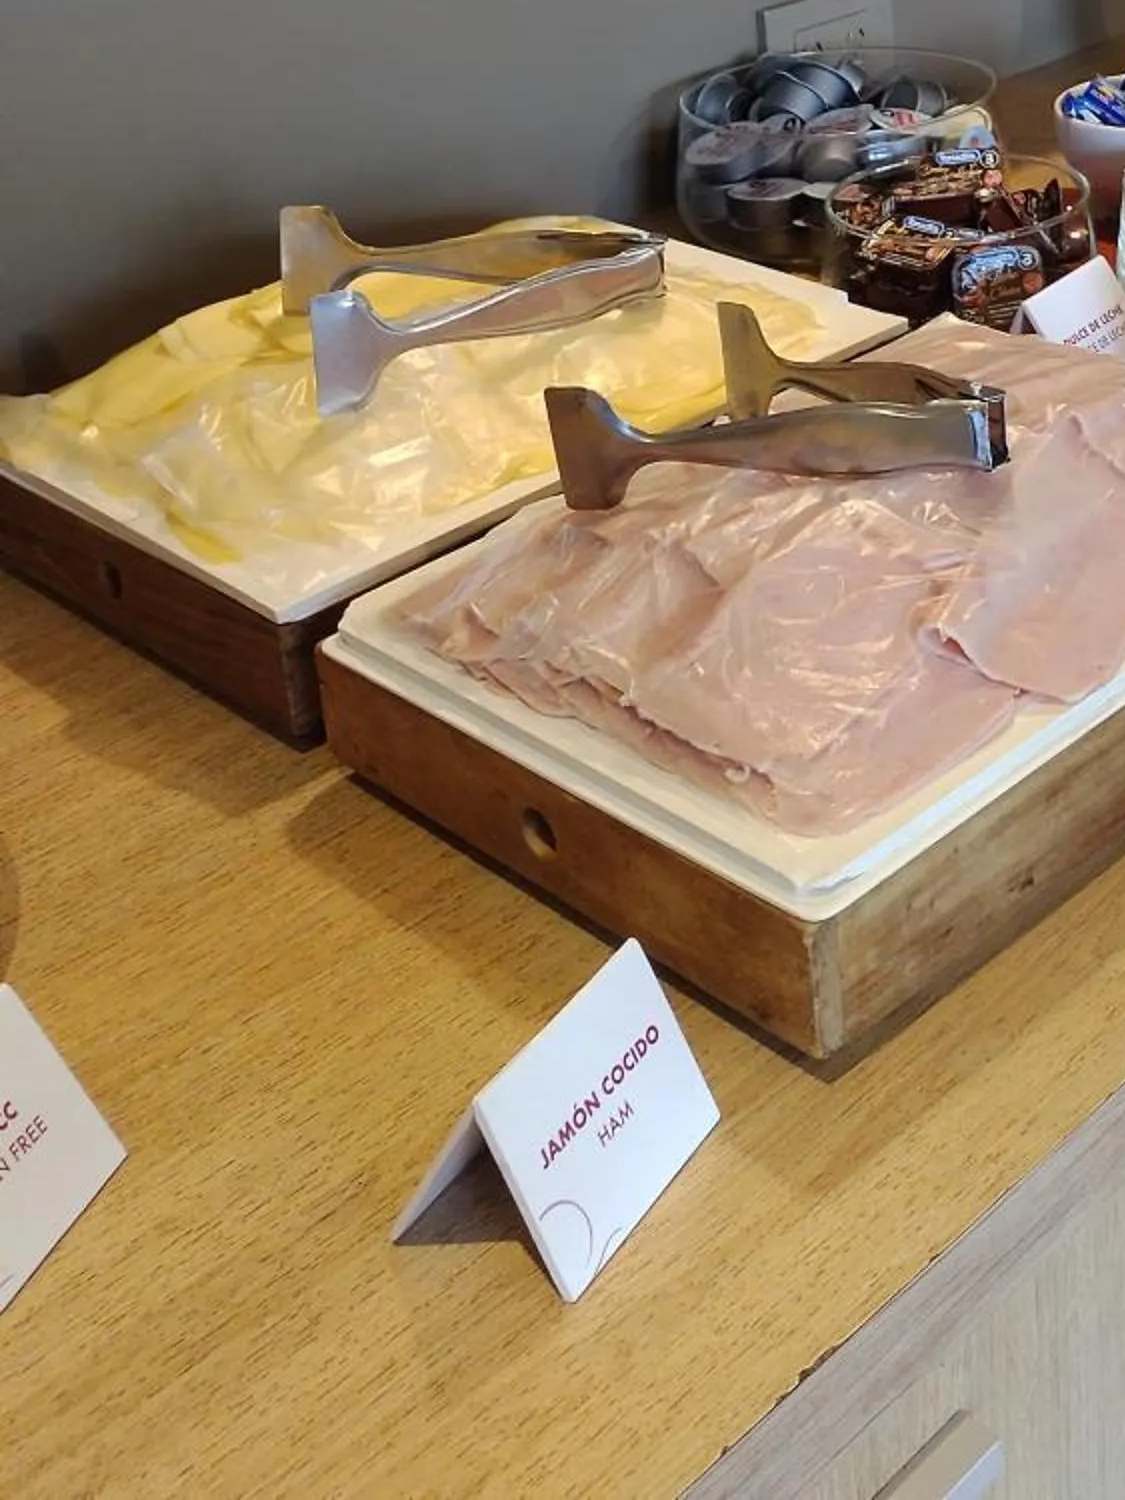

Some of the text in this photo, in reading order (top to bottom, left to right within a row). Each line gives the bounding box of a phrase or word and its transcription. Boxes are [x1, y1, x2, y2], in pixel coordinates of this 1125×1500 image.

[540, 1024, 660, 1170] JAMÓN COCIDO
[9, 1114, 49, 1162] FREE
[596, 1098, 635, 1149] HAM
